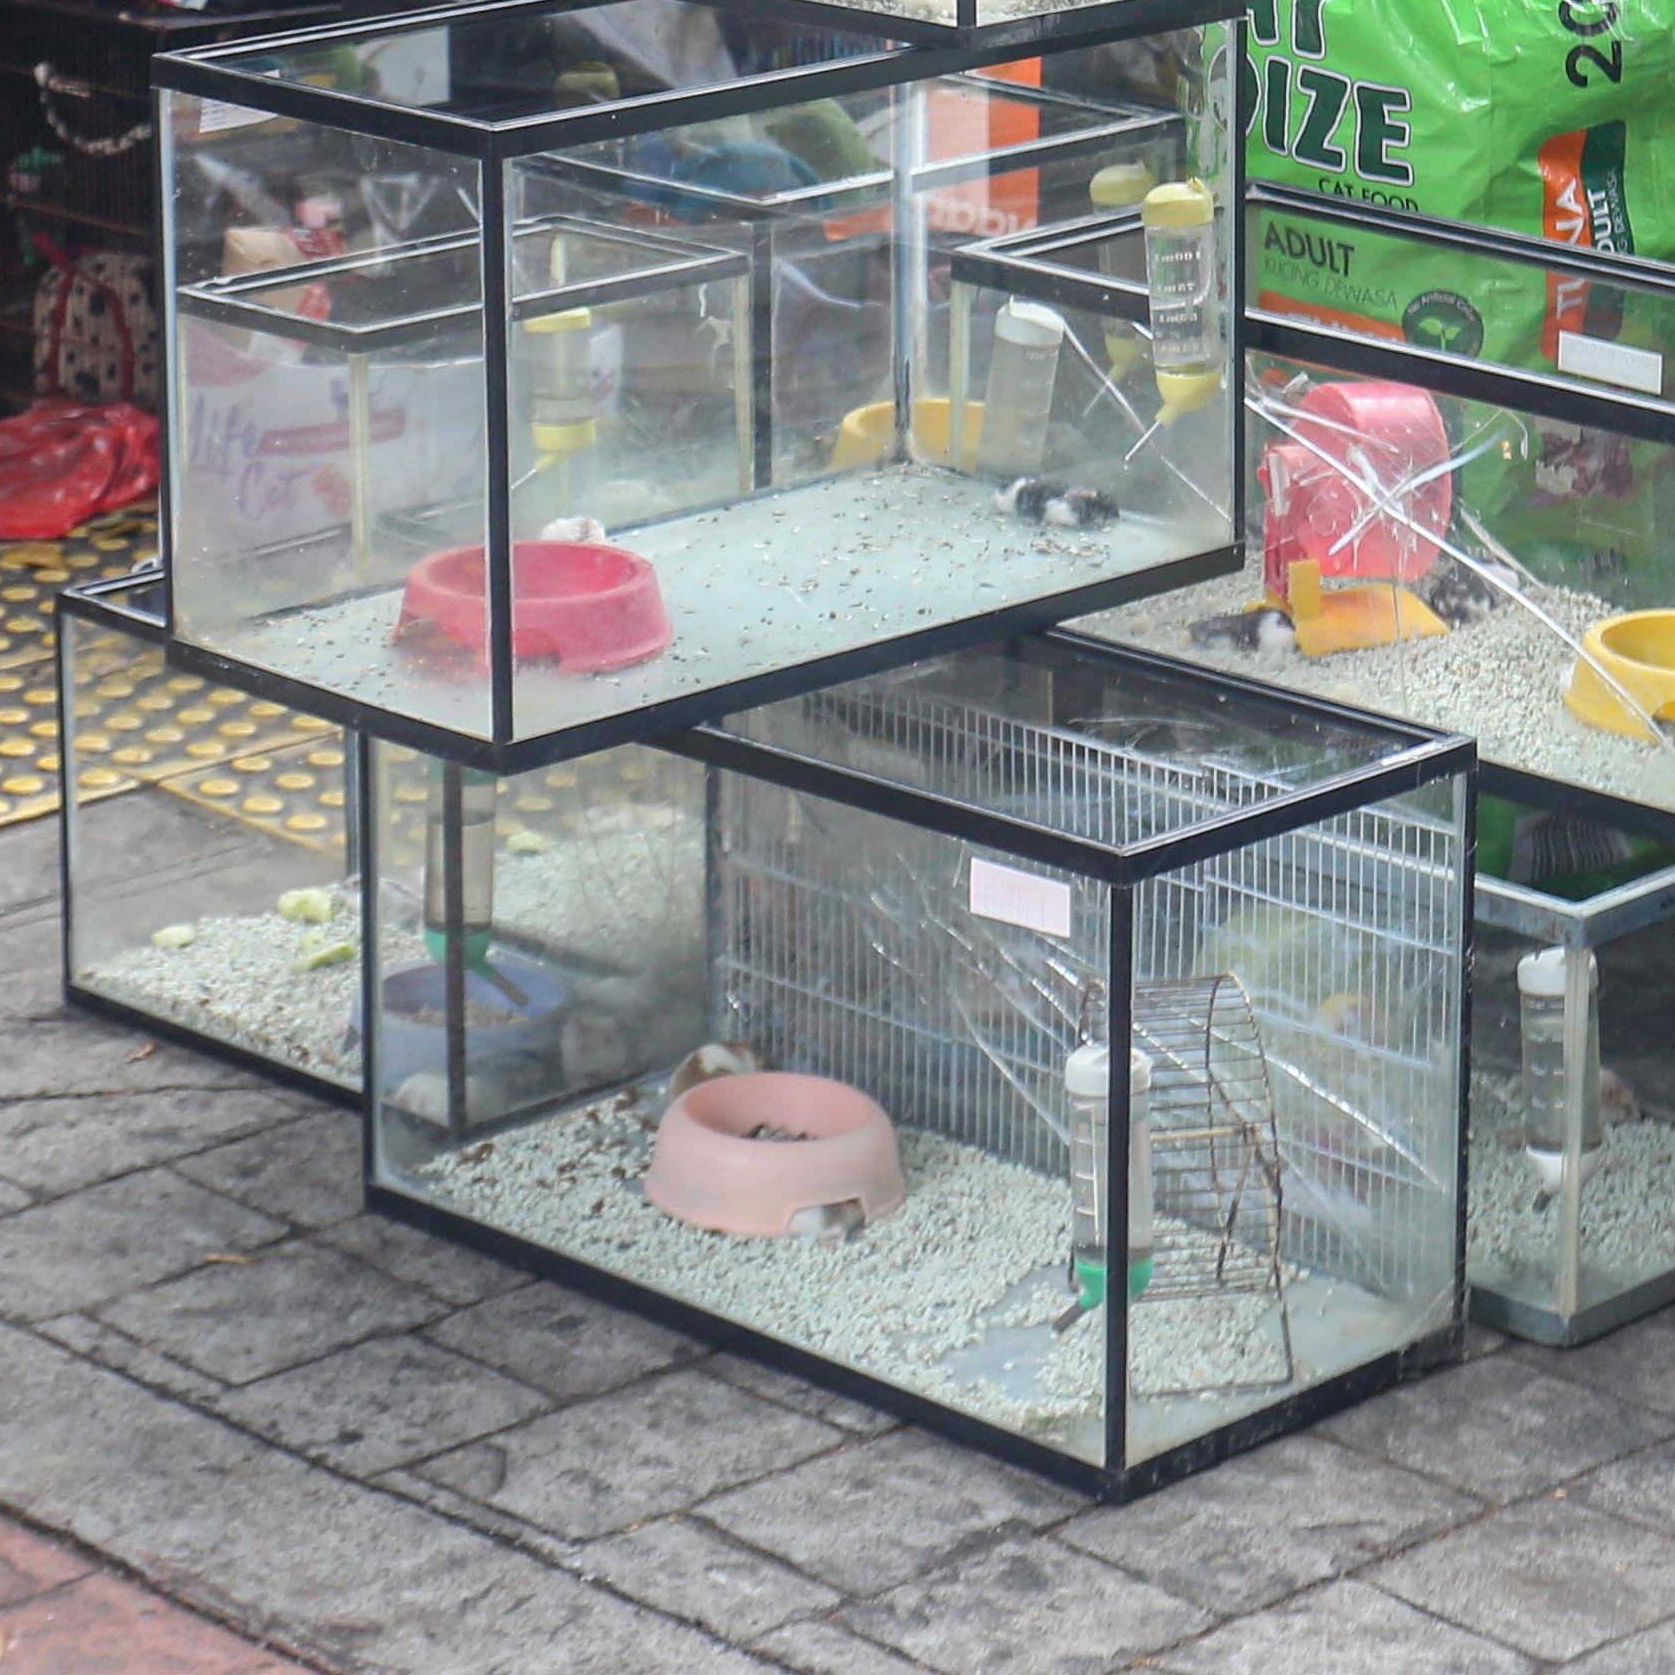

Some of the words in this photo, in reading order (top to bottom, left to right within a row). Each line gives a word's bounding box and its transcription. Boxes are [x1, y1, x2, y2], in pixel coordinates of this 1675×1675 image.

[1264, 220, 1356, 278] ADULT
[1586, 187, 1616, 255] DULT
[1323, 275, 1399, 310] DEWASA
